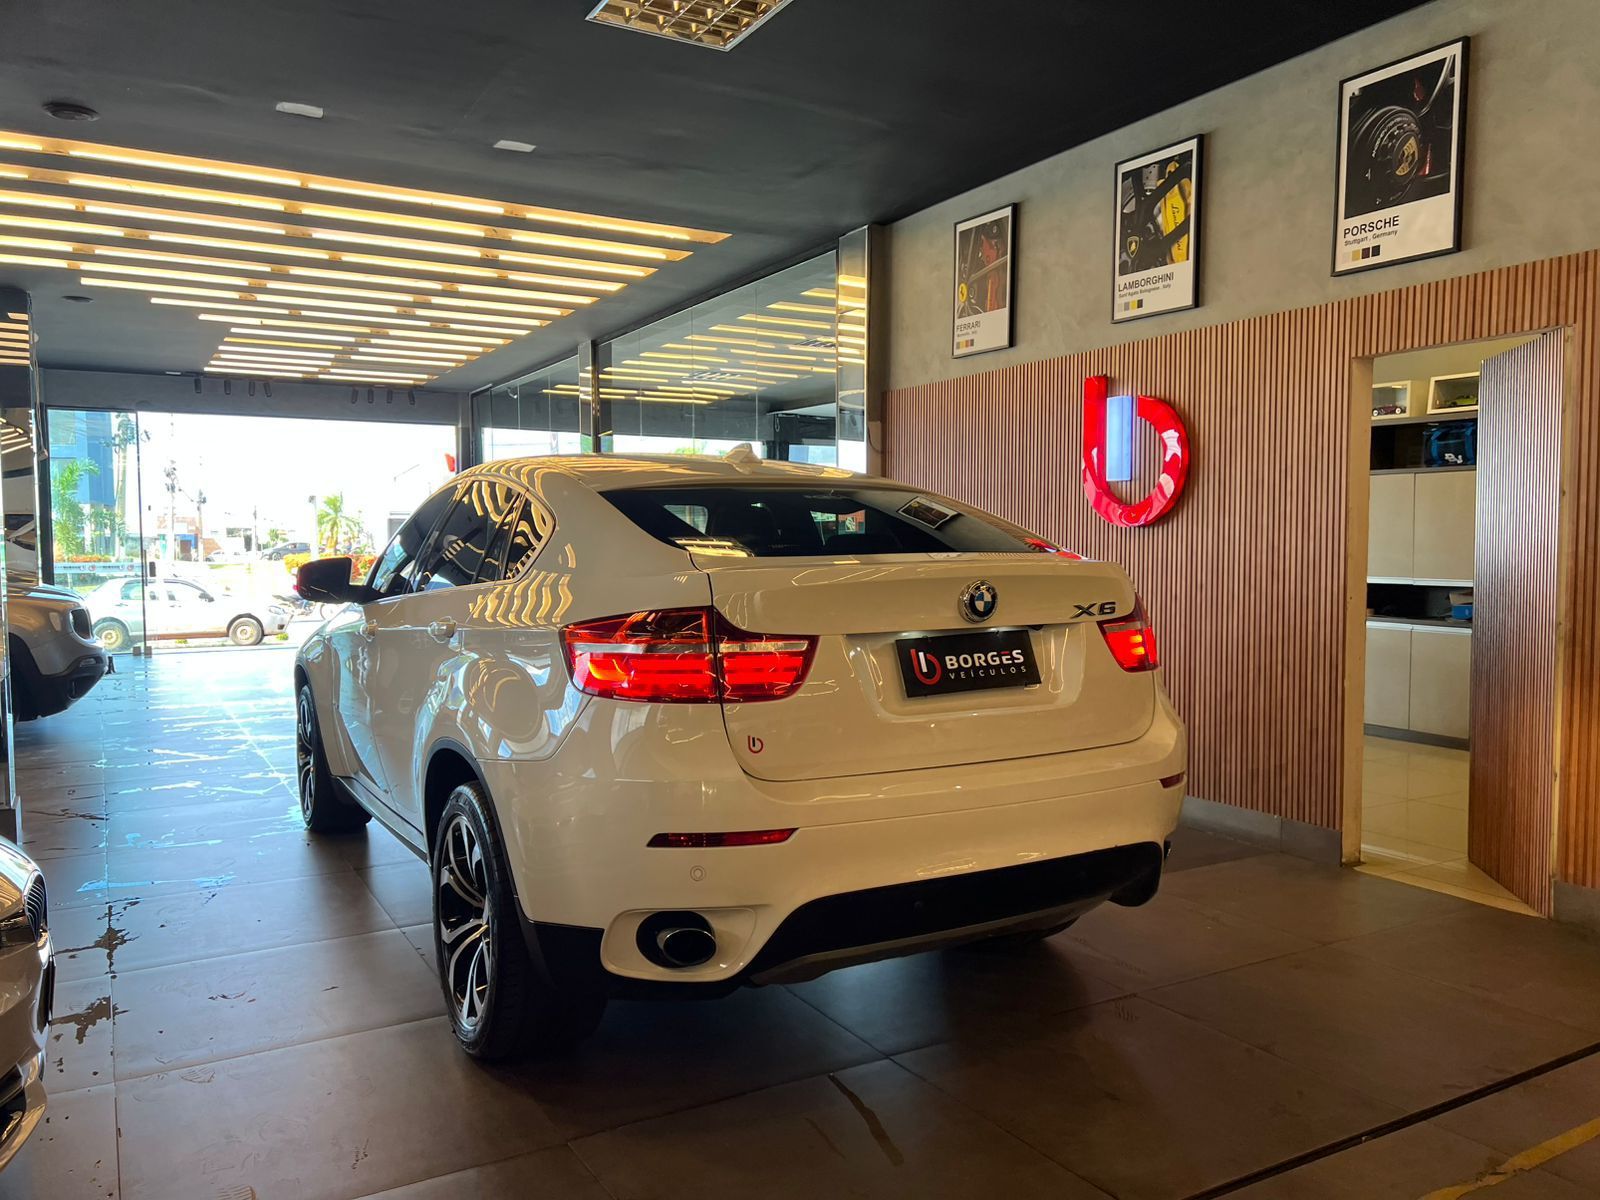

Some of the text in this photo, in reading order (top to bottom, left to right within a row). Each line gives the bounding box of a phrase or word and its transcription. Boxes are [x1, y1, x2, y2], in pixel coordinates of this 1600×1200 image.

[1343, 215, 1400, 239] PORSCHE
[1372, 229, 1398, 240] Germany
[1118, 272, 1174, 292] LAMBORGHINI
[956, 320, 981, 332] FERRARI
[1069, 601, 1116, 619] X6
[945, 649, 1024, 669] BORGES
